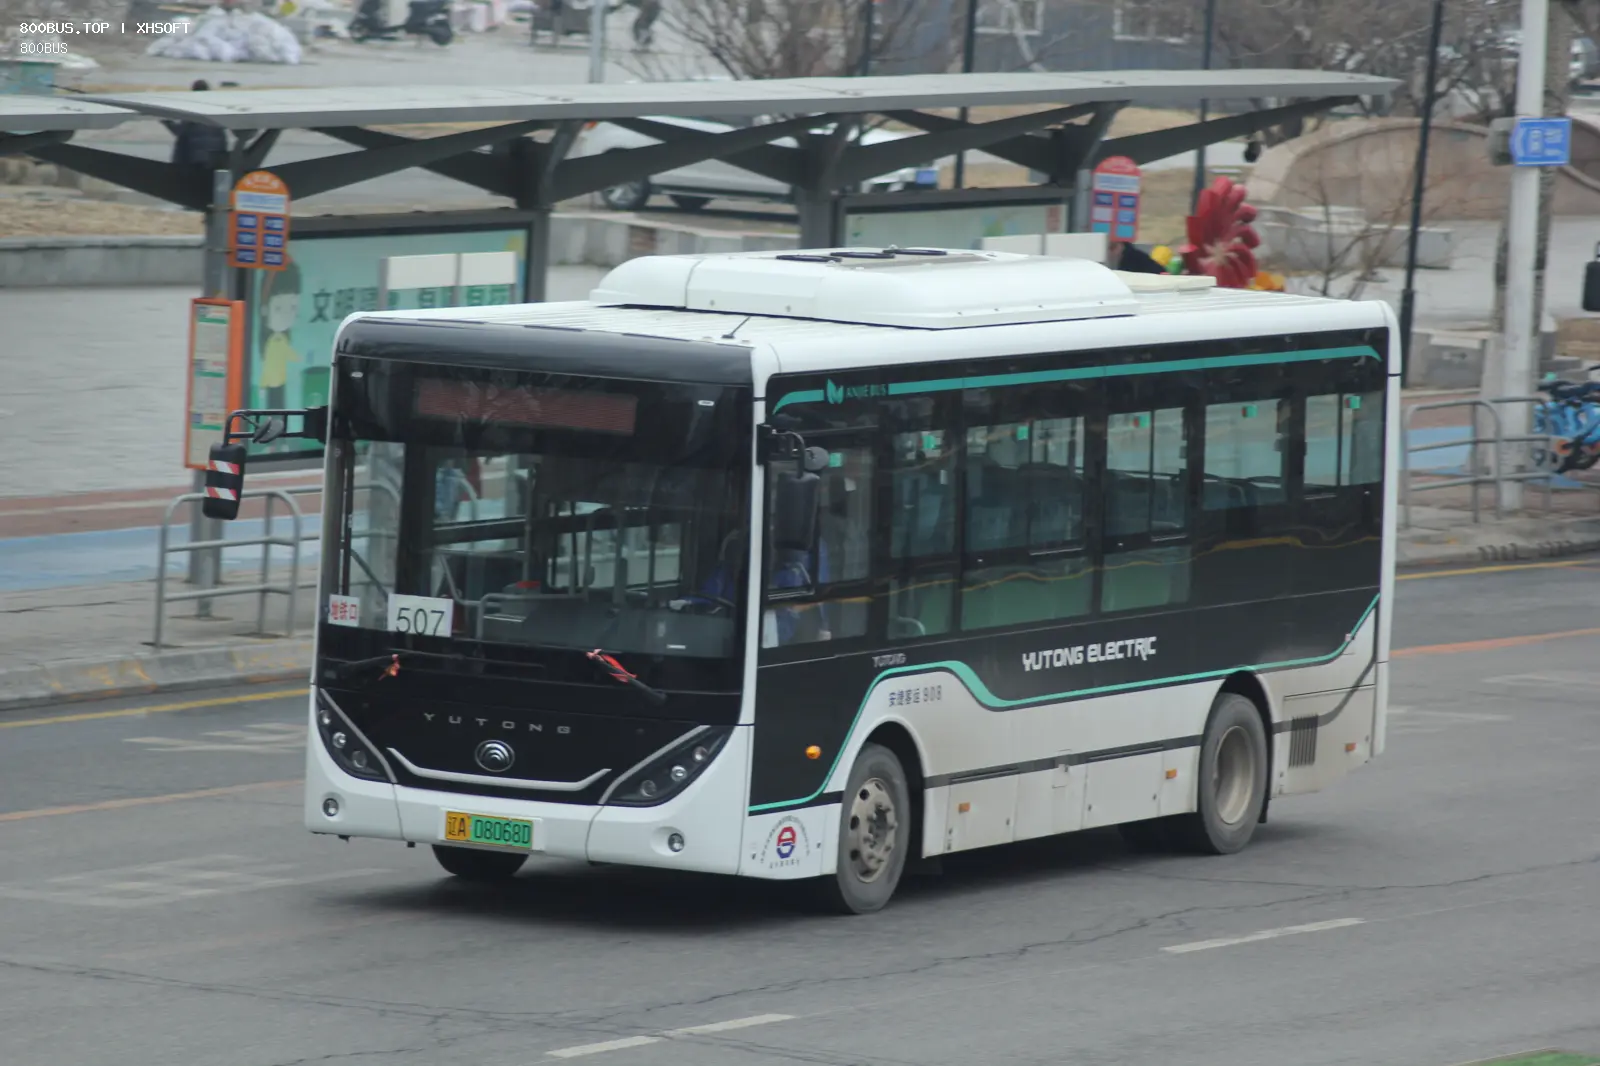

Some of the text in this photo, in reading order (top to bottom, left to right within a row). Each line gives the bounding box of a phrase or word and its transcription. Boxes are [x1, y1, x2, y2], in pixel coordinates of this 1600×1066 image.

[396, 606, 447, 637] 507
[1022, 645, 1084, 672] YUTONG
[423, 712, 573, 734] YUTONG
